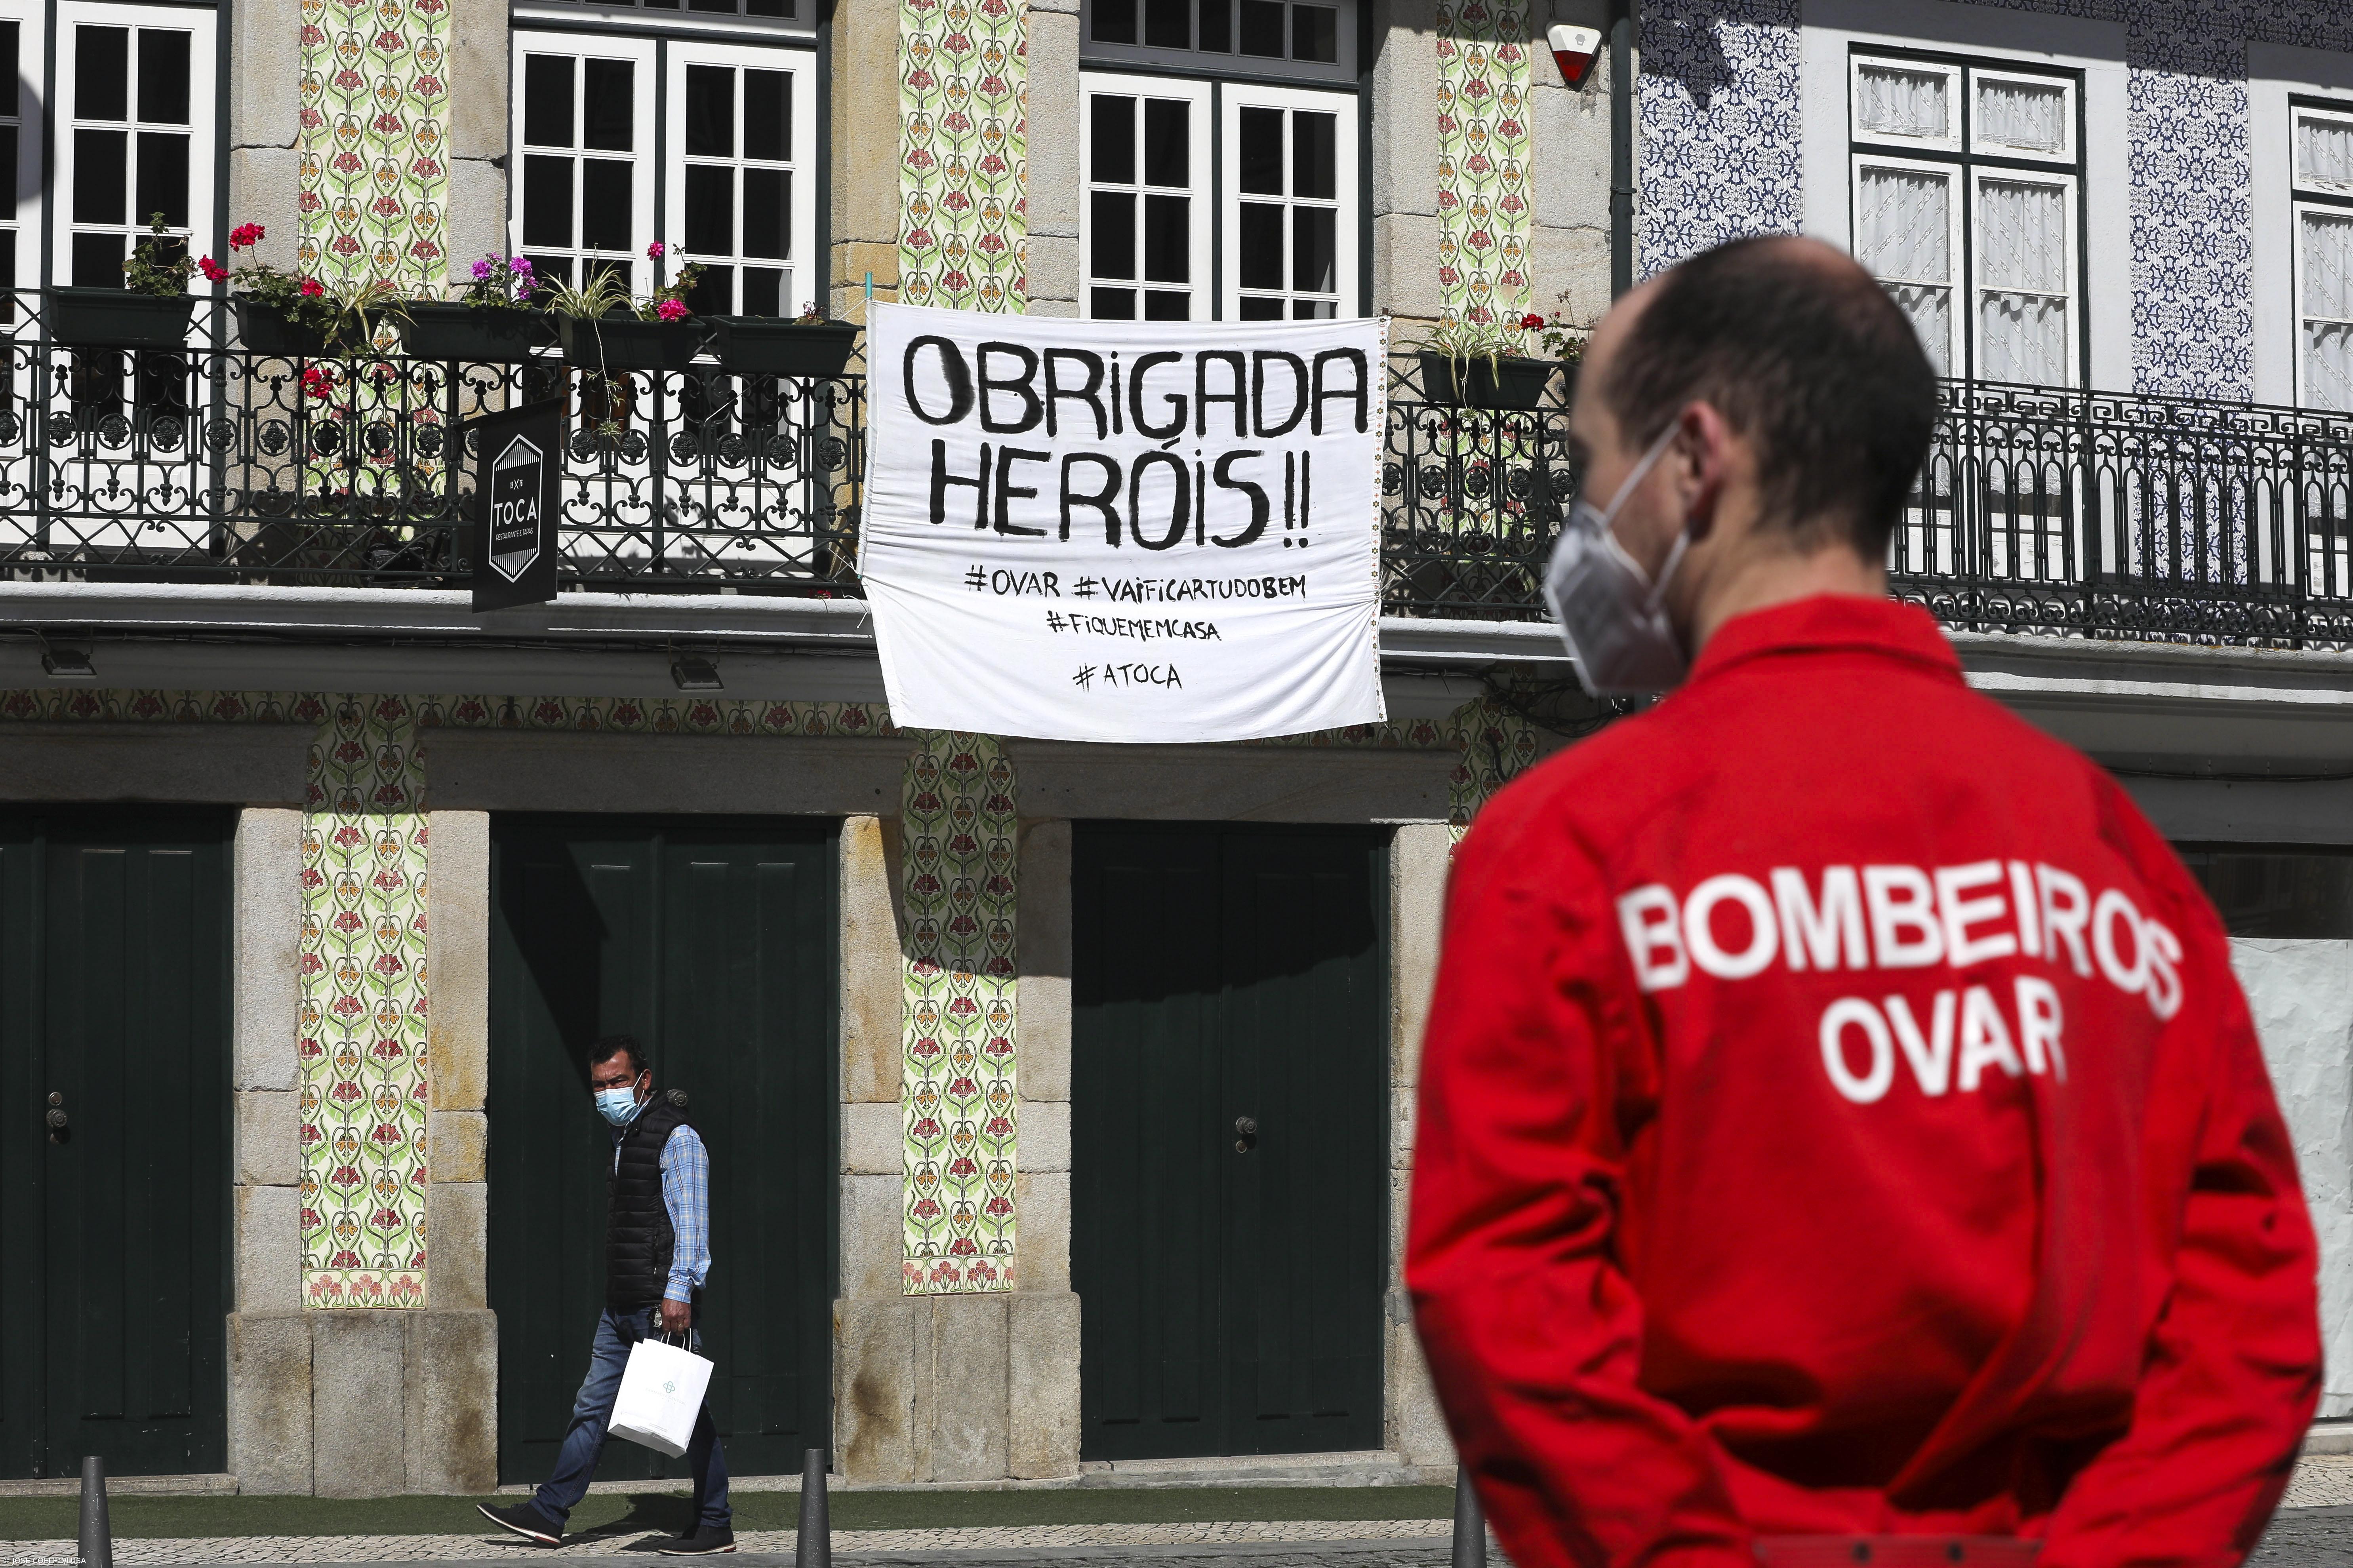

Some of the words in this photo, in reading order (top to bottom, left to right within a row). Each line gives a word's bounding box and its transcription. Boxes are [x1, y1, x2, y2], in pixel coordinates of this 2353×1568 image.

[494, 497, 537, 527] TOCA
[496, 530, 519, 541] RESTAURANTE
[522, 527, 533, 536] TAPAS
[964, 564, 1060, 598] #OVAR
[1617, 859, 2182, 1019] BOMBEIROS
[1819, 974, 2067, 1104] OVAR
